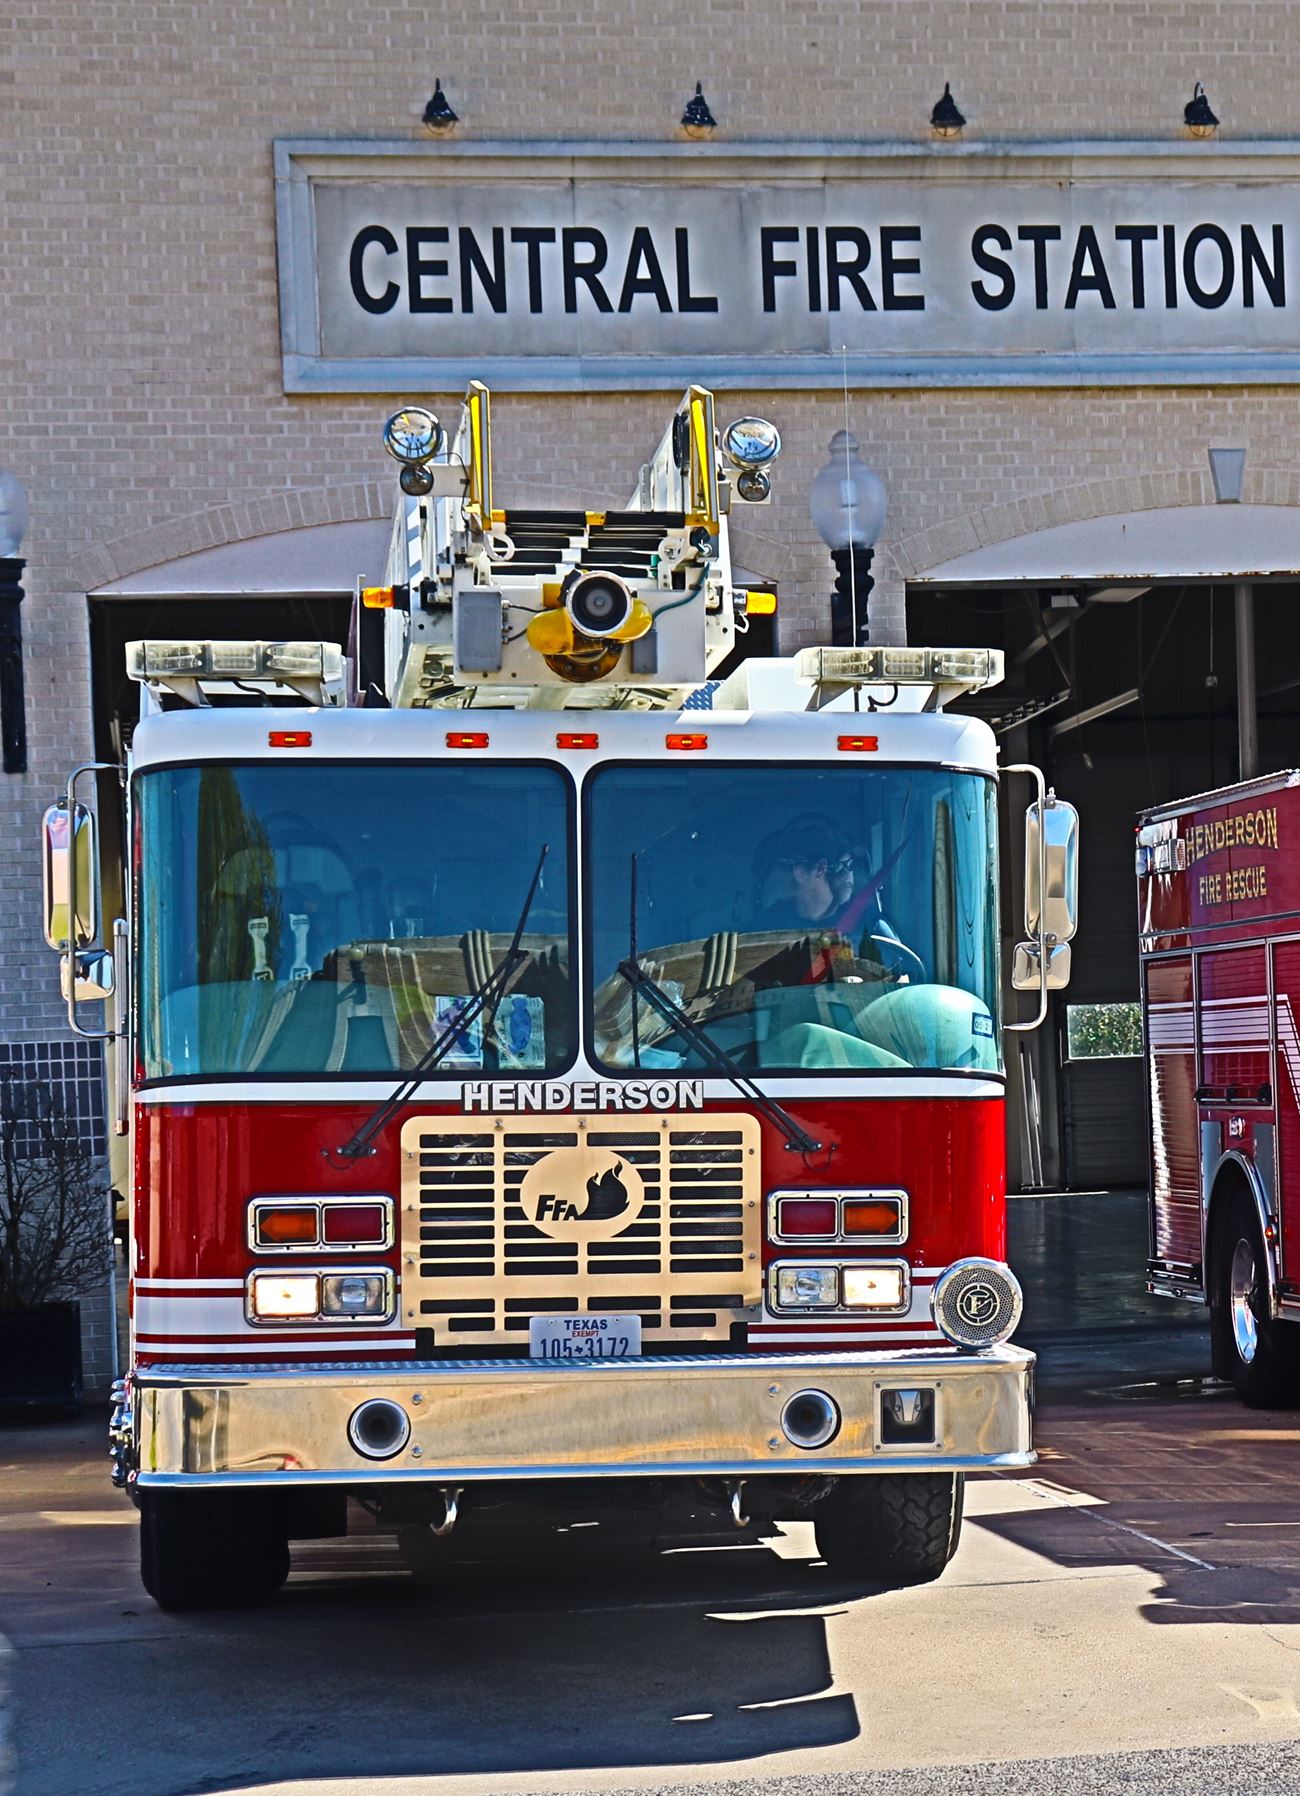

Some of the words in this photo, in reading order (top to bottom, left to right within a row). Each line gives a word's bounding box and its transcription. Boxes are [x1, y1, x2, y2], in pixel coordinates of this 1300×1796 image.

[348, 223, 719, 315] CENTRAL
[761, 224, 926, 314] FIRE
[970, 222, 1289, 312] STATION
[1185, 808, 1279, 867] HENDERSON
[1198, 874, 1222, 906] FIRE
[1225, 865, 1268, 903] RESCUE
[460, 1080, 704, 1111] HENDERSON
[535, 1194, 578, 1222] FFA
[563, 1318, 608, 1331] TEXAS
[571, 1330, 600, 1338] EXEMPT
